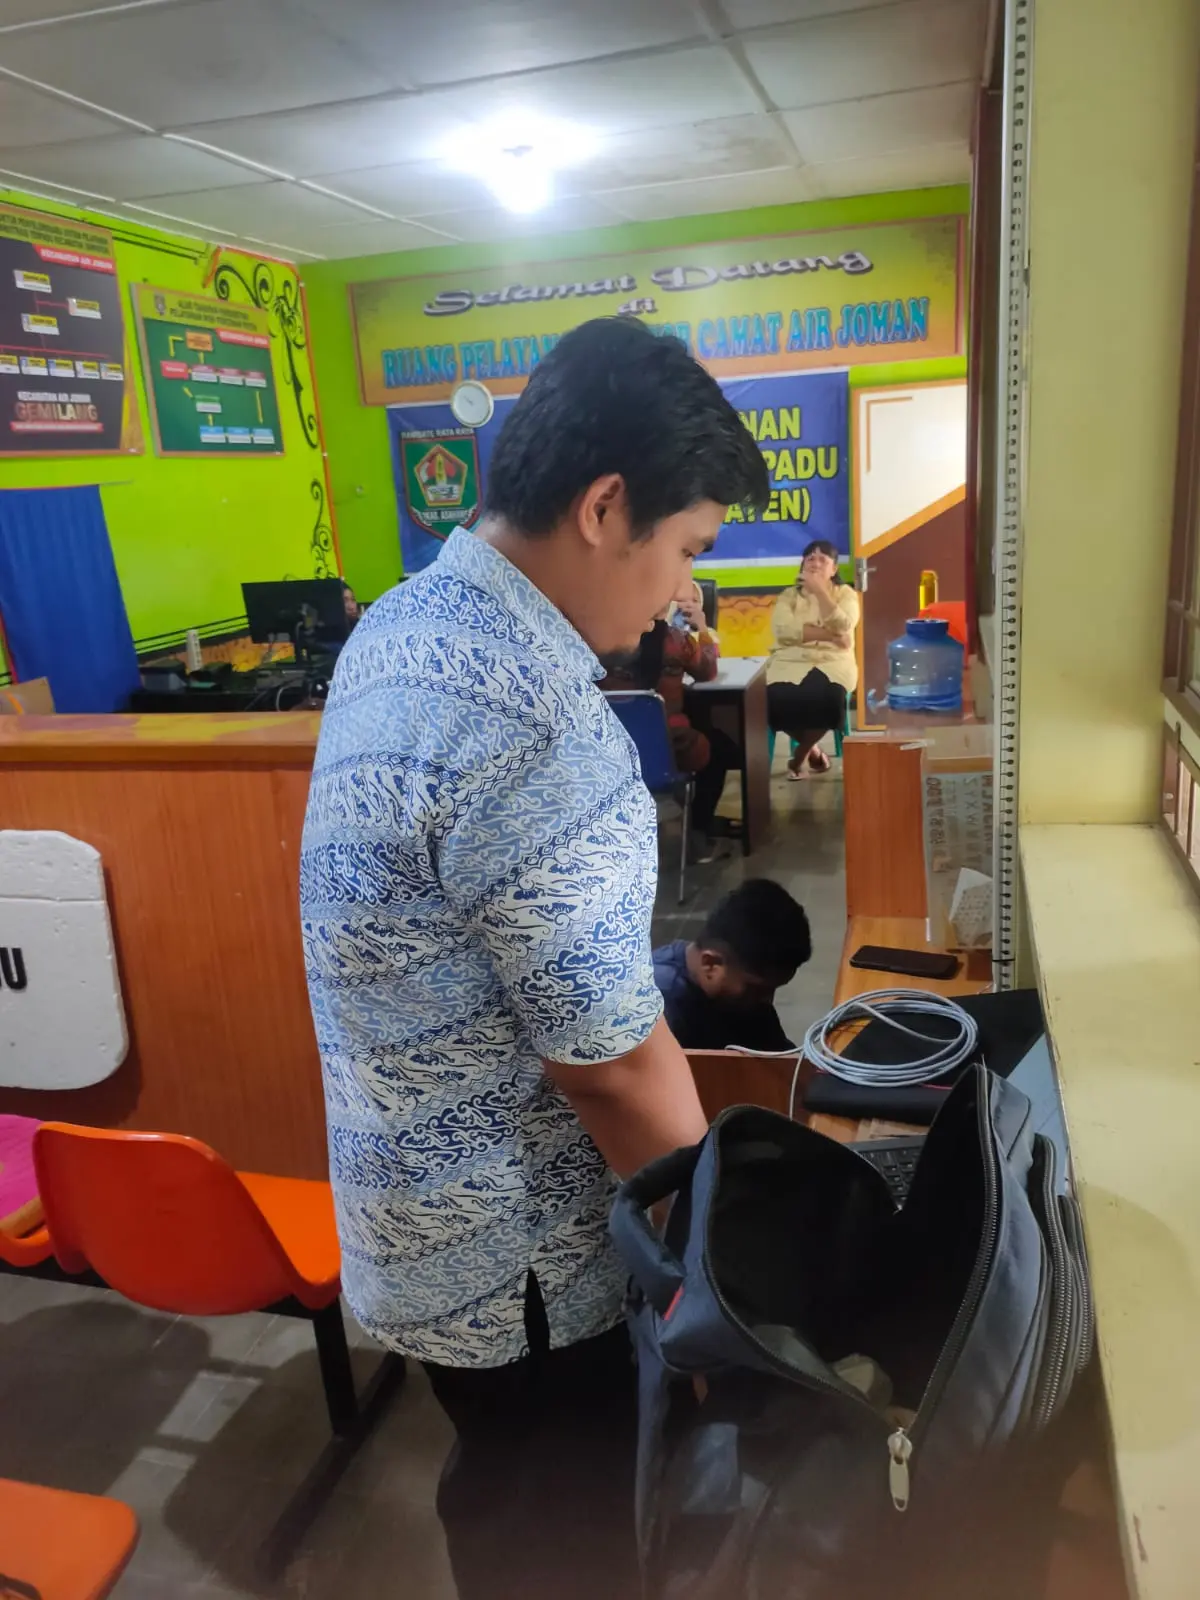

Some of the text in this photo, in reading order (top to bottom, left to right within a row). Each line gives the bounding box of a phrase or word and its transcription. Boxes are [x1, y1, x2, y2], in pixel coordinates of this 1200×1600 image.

[424, 250, 874, 316] Selamat Datang
[617, 297, 657, 316] di
[382, 345, 457, 388] RUANG
[696, 310, 782, 360] CAMAT
[786, 306, 832, 352] AIR
[836, 296, 930, 348] JOMAN
[738, 405, 801, 441] NAN
[760, 446, 838, 481] PADU
[0, 946, 28, 990] U
